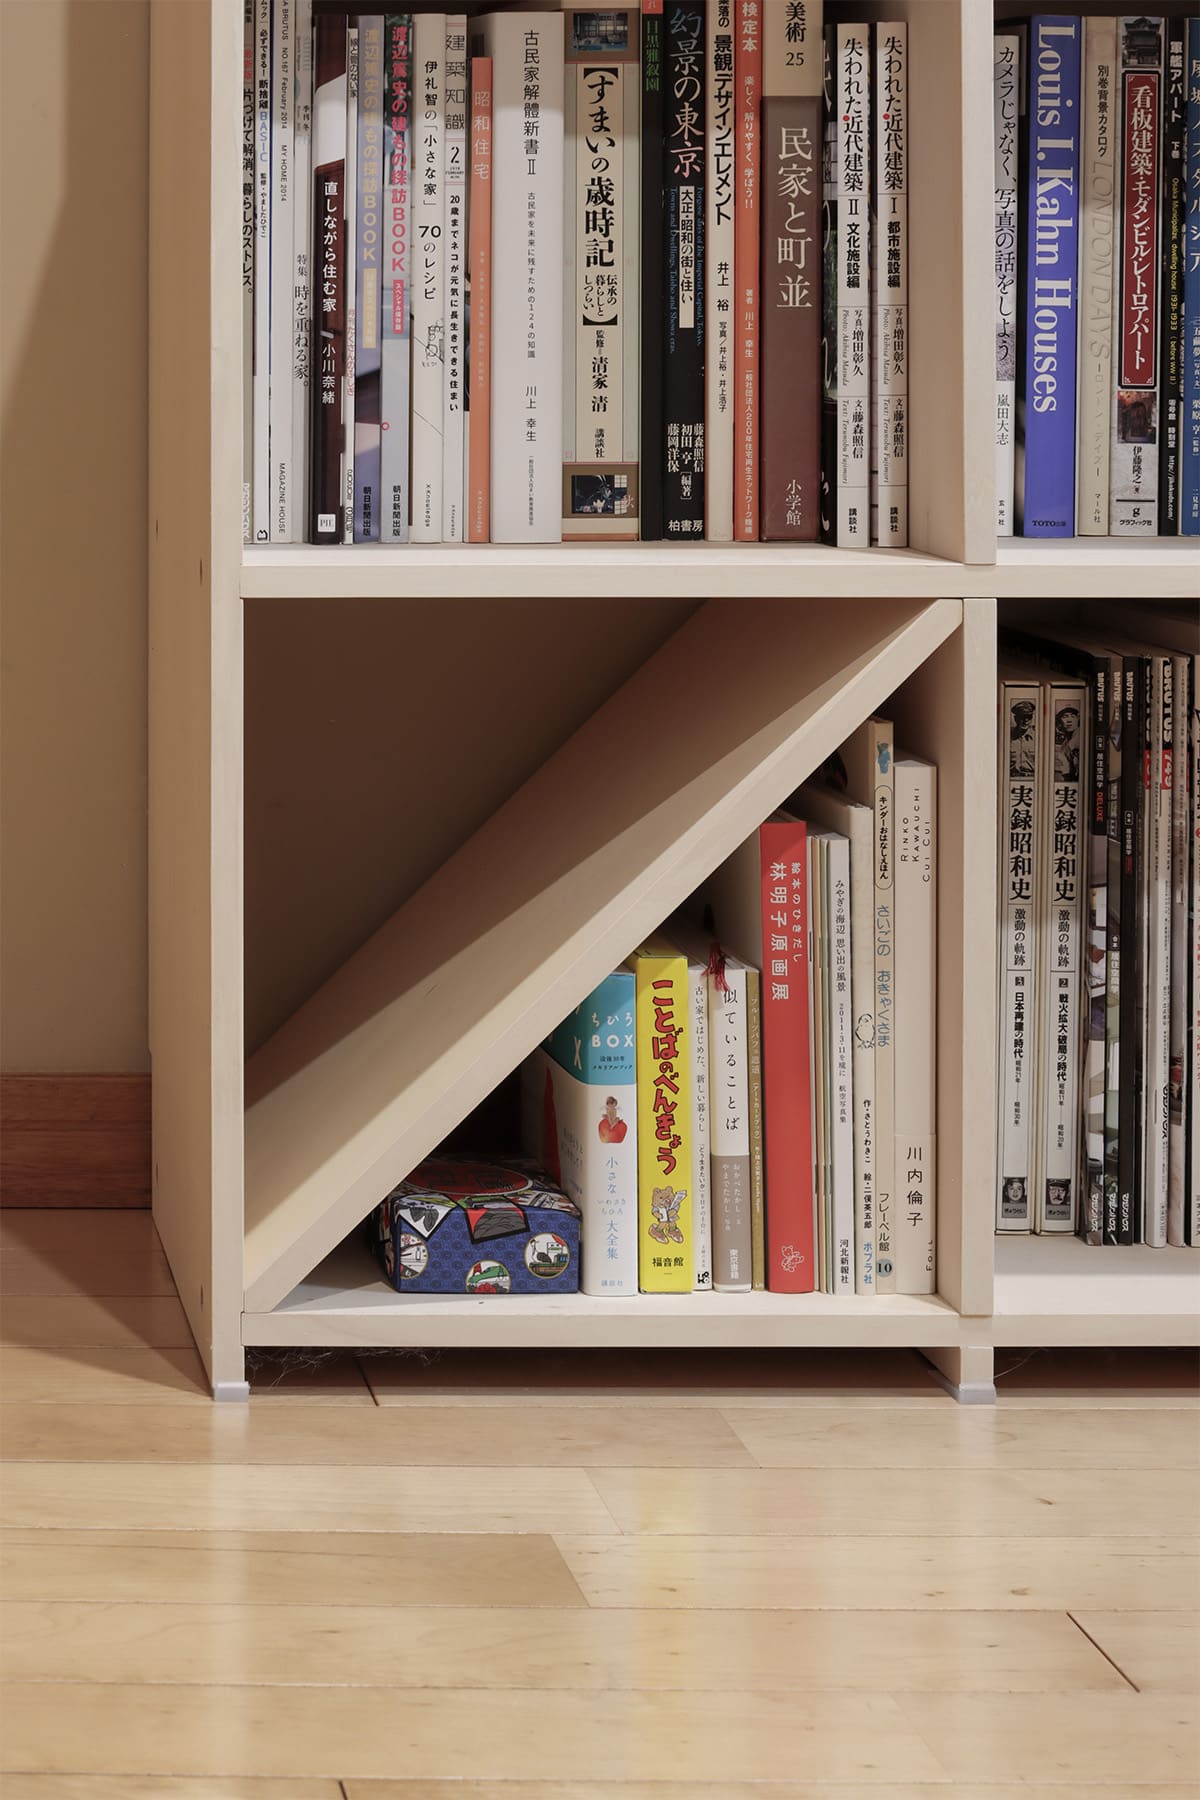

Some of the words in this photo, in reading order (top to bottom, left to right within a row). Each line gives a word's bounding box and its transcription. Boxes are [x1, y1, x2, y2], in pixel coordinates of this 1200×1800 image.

[785, 2, 806, 43] 美術
[445, 34, 465, 131] 建築知識
[785, 52, 805, 66] 25
[1037, 24, 1075, 126] Louis
[280, 77, 289, 110] February
[670, 8, 704, 178] 幻景の東京
[844, 38, 863, 192] 失われた近代建築
[884, 36, 903, 191] 失われた近代建築
[281, 144, 287, 156] MY
[423, 60, 438, 206] 伊礼智の「小さな家」
[450, 145, 460, 164] 2
[474, 90, 491, 180] 昭和住宅
[714, 34, 733, 226] 景観デザインエレメント
[776, 127, 813, 309] 民家と町並
[995, 46, 1016, 361] カメラじゃなく、写真の話をしよう
[1090, 161, 1113, 277] LONDON
[1129, 86, 1153, 371] 看板建築・モダンビル・レトロアパート
[323, 181, 338, 313] 直しながら住む家
[681, 188, 693, 304] 大正・昭和の街と住い
[717, 262, 729, 286] 井上
[846, 222, 860, 289] 文化施設編
[888, 221, 901, 288] 都市施設編
[607, 274, 618, 306] 伝承の
[717, 299, 729, 312] 裕
[1089, 285, 1110, 359] DAYS
[322, 343, 336, 404] 小川奈緒
[1033, 278, 1072, 413] Houses
[526, 385, 537, 410] 川上
[392, 485, 401, 537] 朝日新聞出版
[668, 519, 703, 532] 柏書房
[785, 479, 802, 526] 小学館
[1113, 671, 1121, 702] BRUTUS
[1126, 671, 1134, 702] BRUTUS
[879, 796, 889, 881] キンダーおはなしえほん
[900, 817, 909, 862] RINKO
[912, 788, 920, 862] KAWAUCHI
[1009, 785, 1033, 901] 実録昭和史
[1054, 786, 1077, 902] 実録昭和史
[769, 861, 789, 1001] 林明子原画展
[791, 861, 803, 963] 絵本のひきだし
[835, 879, 846, 935] みやぎの海辺
[877, 905, 891, 956] さいごの
[1014, 908, 1026, 967] 激動の軌跡
[1058, 909, 1071, 968] 激動の軌跡
[836, 938, 846, 992] 思い出の風景
[591, 1035, 633, 1048] BOX
[724, 989, 740, 1131] 似ていることば
[652, 979, 684, 1176] ことばのべんきょう
[606, 1156, 619, 1194] 小さな
[907, 1146, 923, 1227] 川内倫子
[606, 1220, 619, 1260] 大全集
[879, 1192, 890, 1252] フレーベル館
[652, 1256, 684, 1267] 福音館
[877, 1263, 892, 1273] 10
